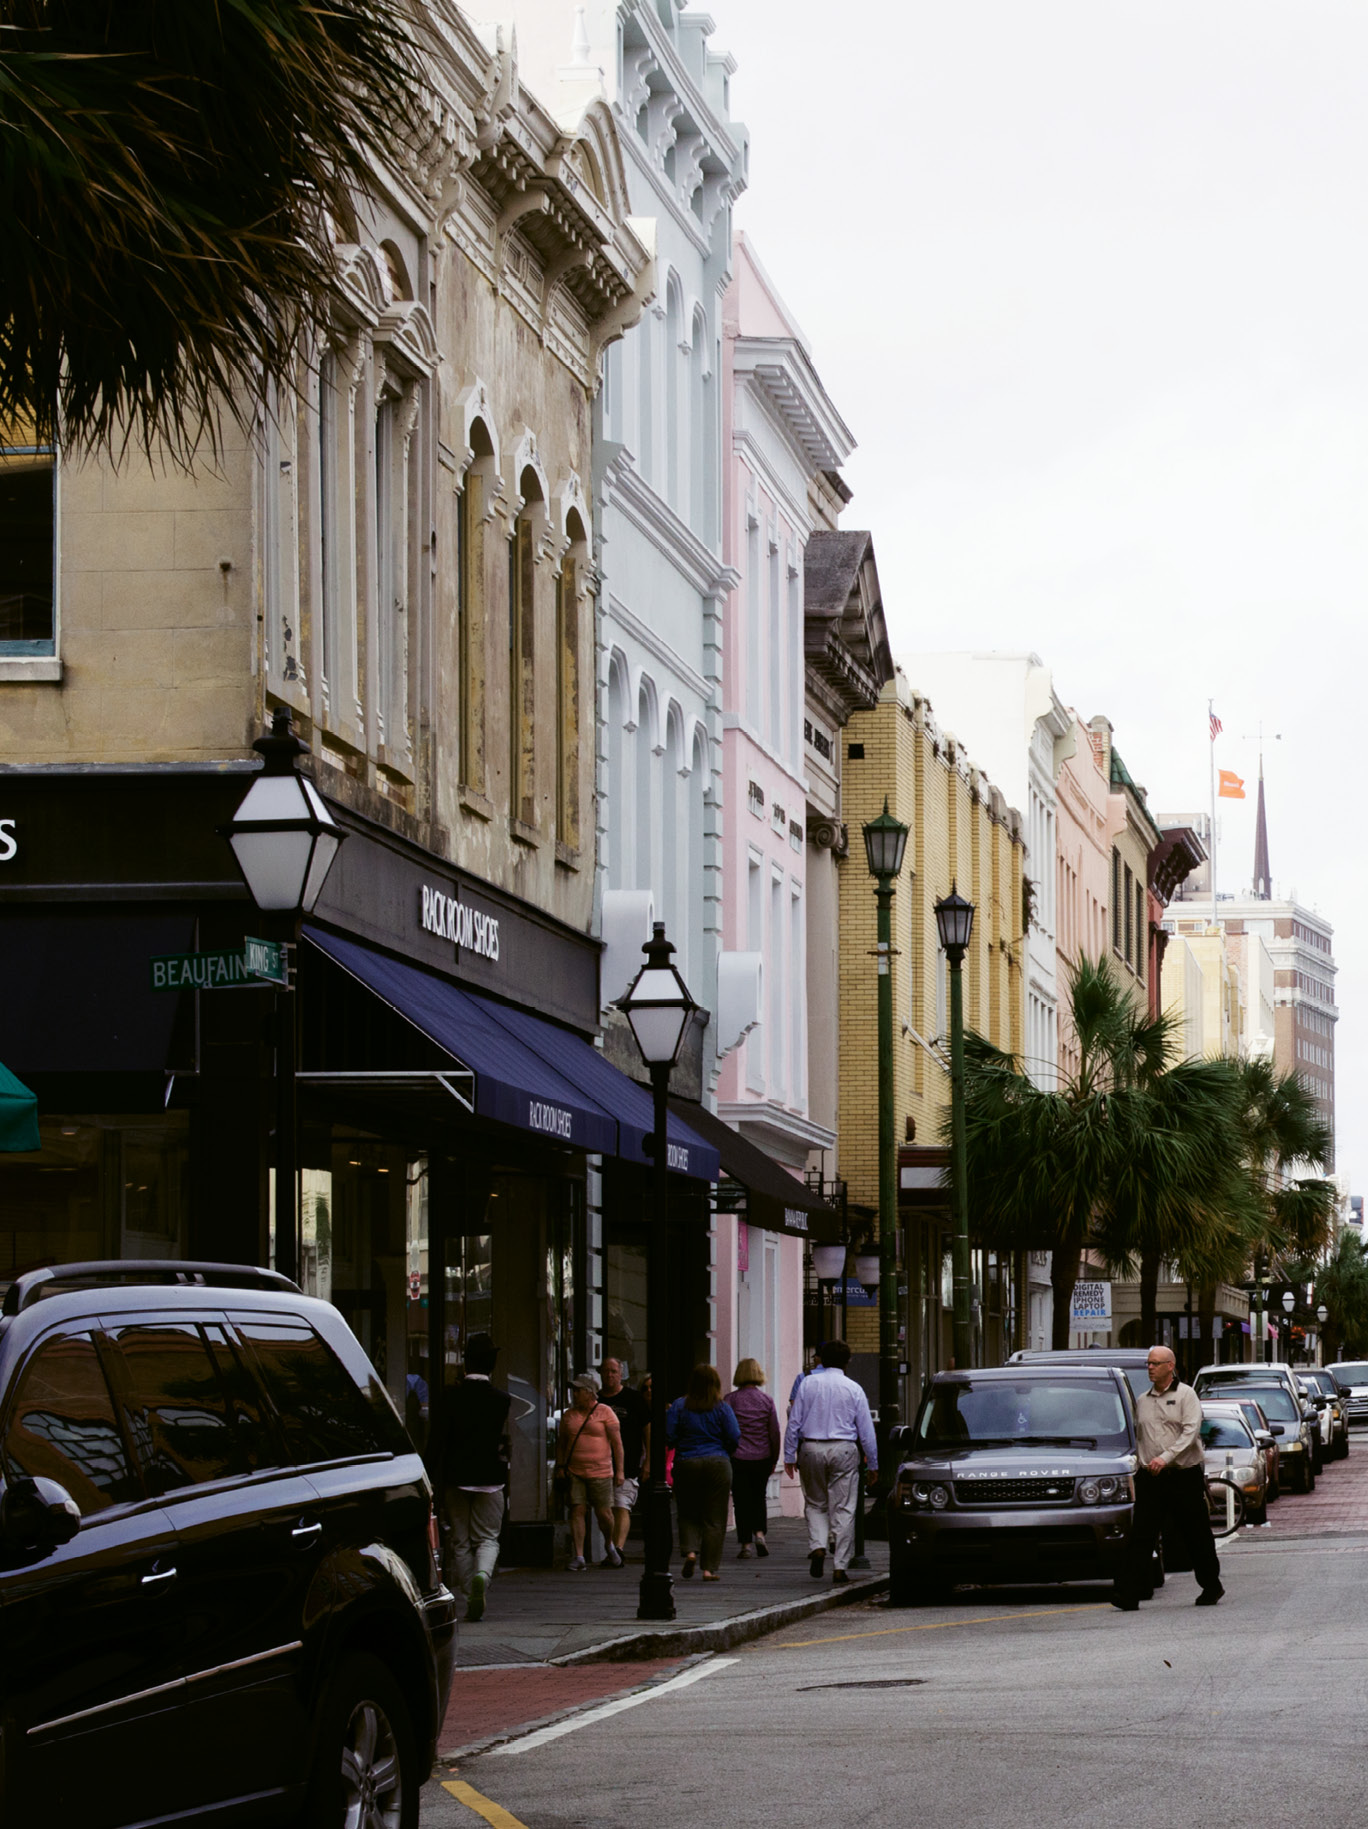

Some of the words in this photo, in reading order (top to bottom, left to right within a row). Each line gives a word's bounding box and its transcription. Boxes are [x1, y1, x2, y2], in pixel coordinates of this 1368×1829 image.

[422, 884, 447, 938] RACK
[447, 896, 473, 950] ROOM
[474, 910, 499, 962] SHOES
[153, 954, 248, 988] BEAUFAIN
[249, 942, 269, 972] KING
[271, 952, 279, 969] ST
[529, 1100, 542, 1129] RACK
[542, 1104, 557, 1134] ROOM
[557, 1108, 572, 1139] SHOES
[1073, 1283, 1105, 1291] DIGITAL
[1073, 1309, 1106, 1317] REPAIR
[957, 1470, 1009, 1479] RANGE
[1018, 1468, 1071, 1477] ROVER
